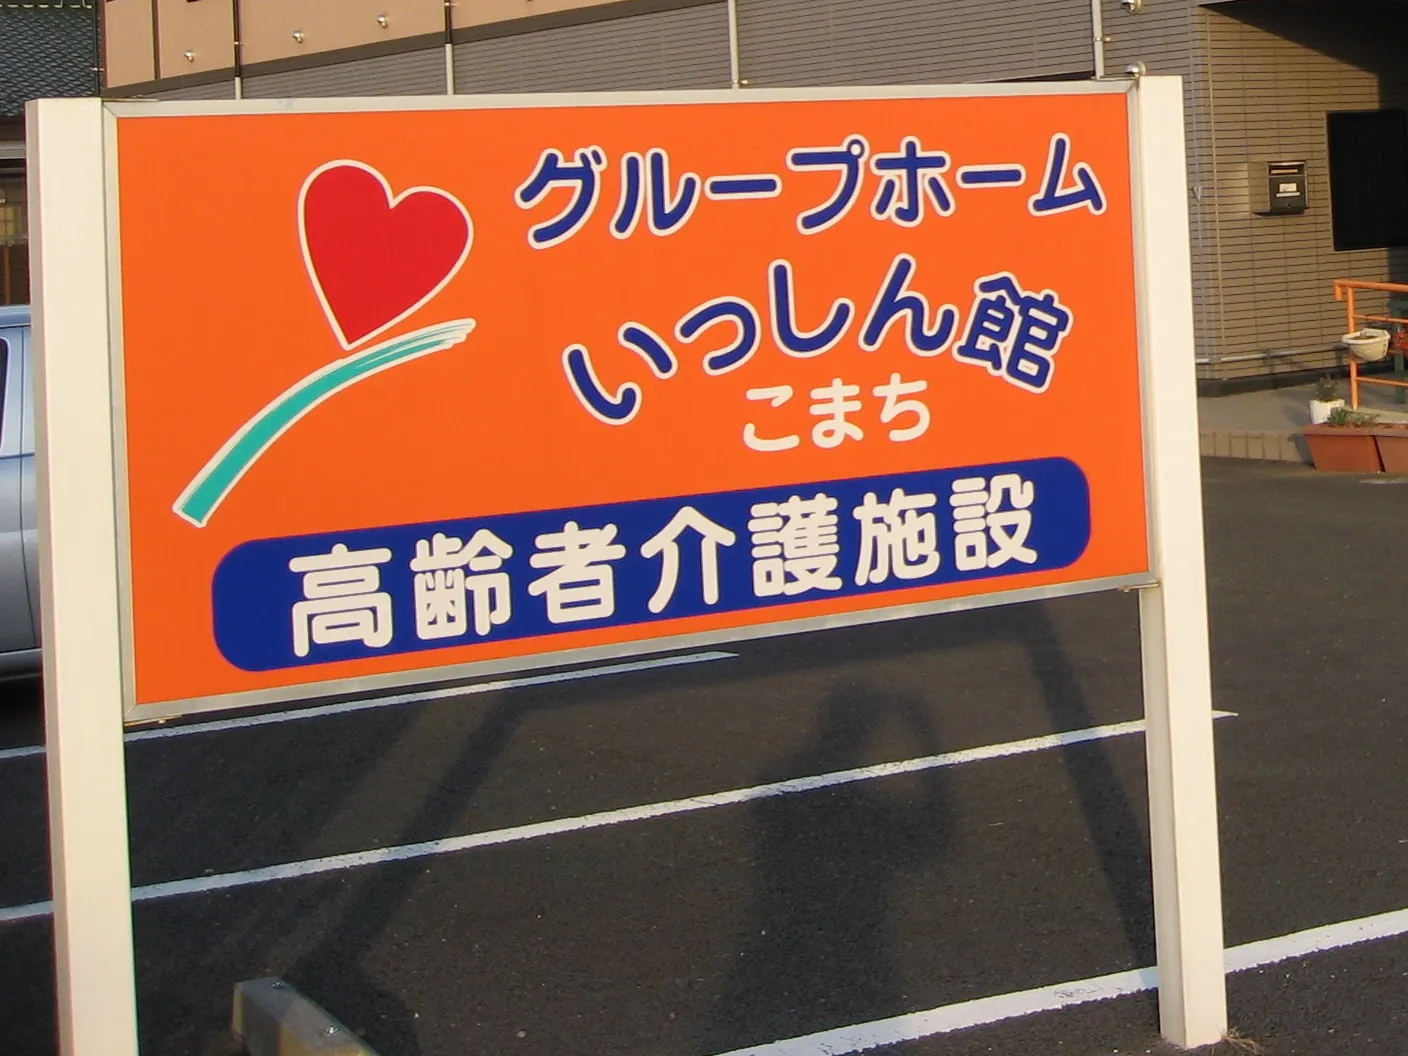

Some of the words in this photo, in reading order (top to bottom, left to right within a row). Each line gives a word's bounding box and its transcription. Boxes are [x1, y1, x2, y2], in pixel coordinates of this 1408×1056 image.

[513, 132, 1107, 250] グループホーム
[561, 253, 1073, 427] いっしん館
[743, 373, 930, 452] こまち
[288, 472, 1038, 658] 高齢者介護施設
